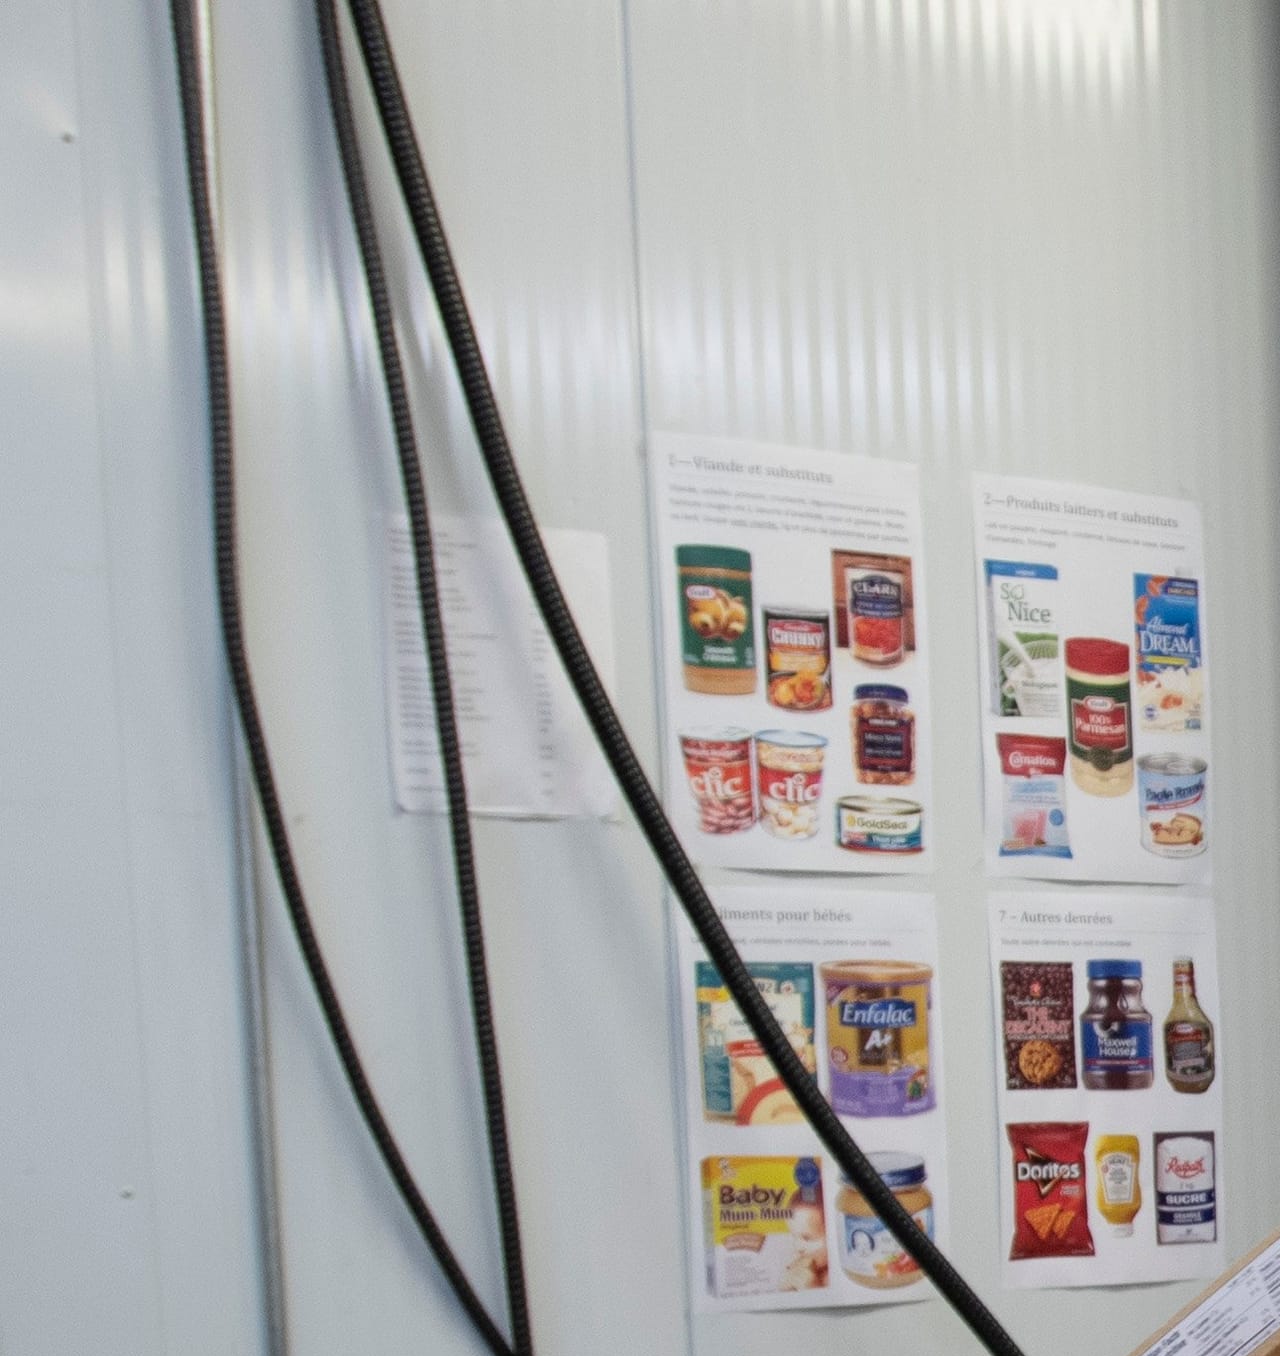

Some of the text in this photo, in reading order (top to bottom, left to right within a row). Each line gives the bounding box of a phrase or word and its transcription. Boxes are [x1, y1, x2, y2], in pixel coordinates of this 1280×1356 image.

[853, 582, 897, 597] CLARK
[1006, 601, 1051, 624] Nice
[771, 629, 824, 647] CHUNKY
[1076, 717, 1126, 734] Parmesan
[1009, 751, 1057, 769] Carnation
[691, 767, 742, 801] clic
[769, 773, 821, 804] clic
[777, 910, 810, 924] pour
[813, 908, 853, 923] bébés
[999, 910, 1007, 923] 7
[1020, 911, 1061, 923] Autres
[1064, 911, 1113, 925] denrées
[843, 1001, 914, 1024] Enfalac
[1098, 1037, 1138, 1048] Maxwell
[1099, 1047, 1134, 1057] House
[1018, 1163, 1080, 1180] Doritos
[720, 1184, 785, 1206] Baby
[1165, 1192, 1207, 1205] SUCRE
